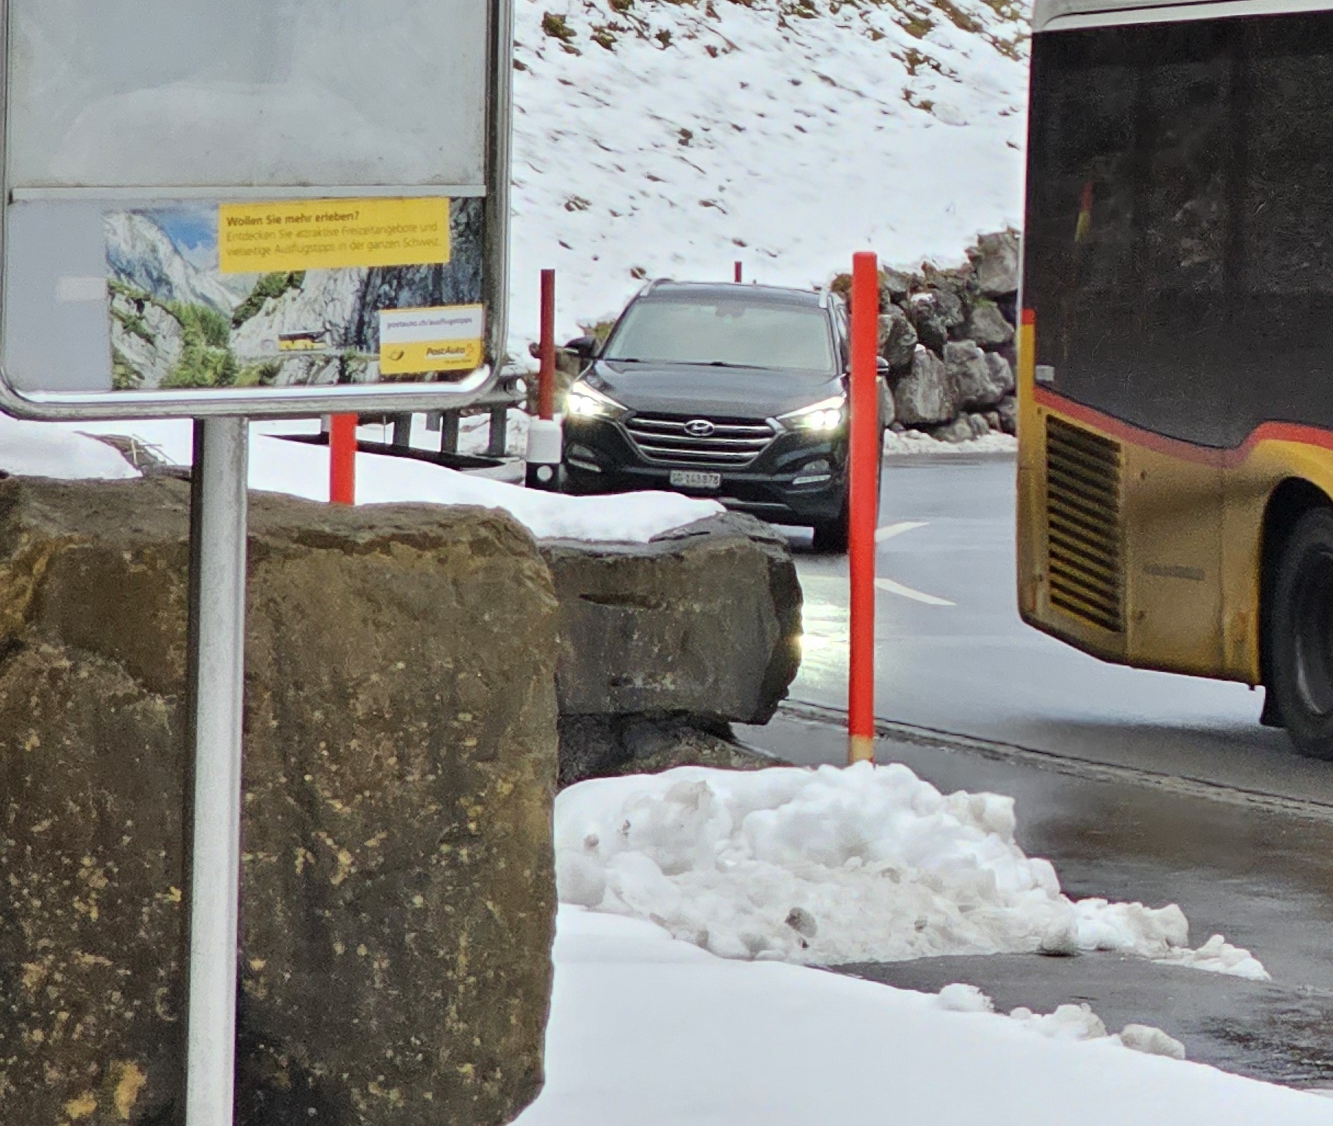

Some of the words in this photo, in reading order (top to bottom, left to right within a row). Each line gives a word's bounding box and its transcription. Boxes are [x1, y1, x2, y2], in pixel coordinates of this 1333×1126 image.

[226, 215, 263, 227] Wollen
[266, 214, 282, 225] Sie
[284, 213, 312, 224] mehr
[315, 211, 359, 223] erleben?
[426, 345, 466, 356] PostAuto
